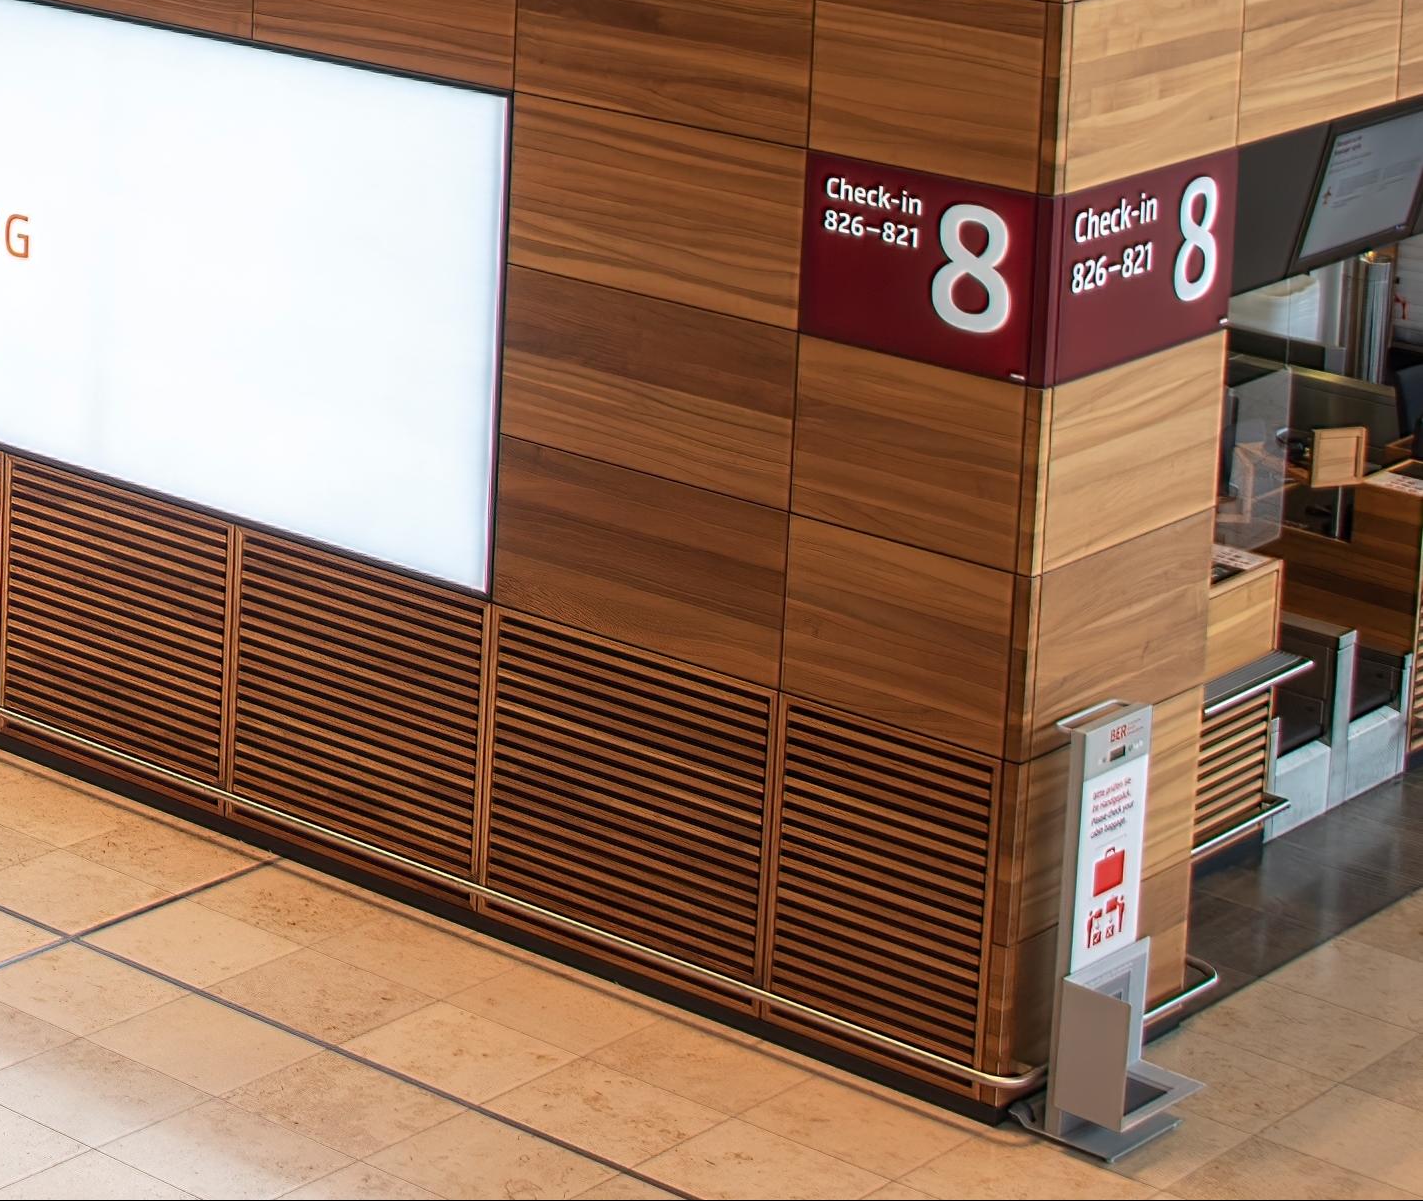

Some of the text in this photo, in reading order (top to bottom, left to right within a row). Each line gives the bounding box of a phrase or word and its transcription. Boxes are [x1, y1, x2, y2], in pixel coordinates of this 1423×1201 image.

[826, 177, 922, 216] Check-in
[1075, 192, 1158, 243] Check-in
[1173, 176, 1218, 302] 8
[931, 203, 1011, 333] 8
[1110, 723, 1128, 742] BER
